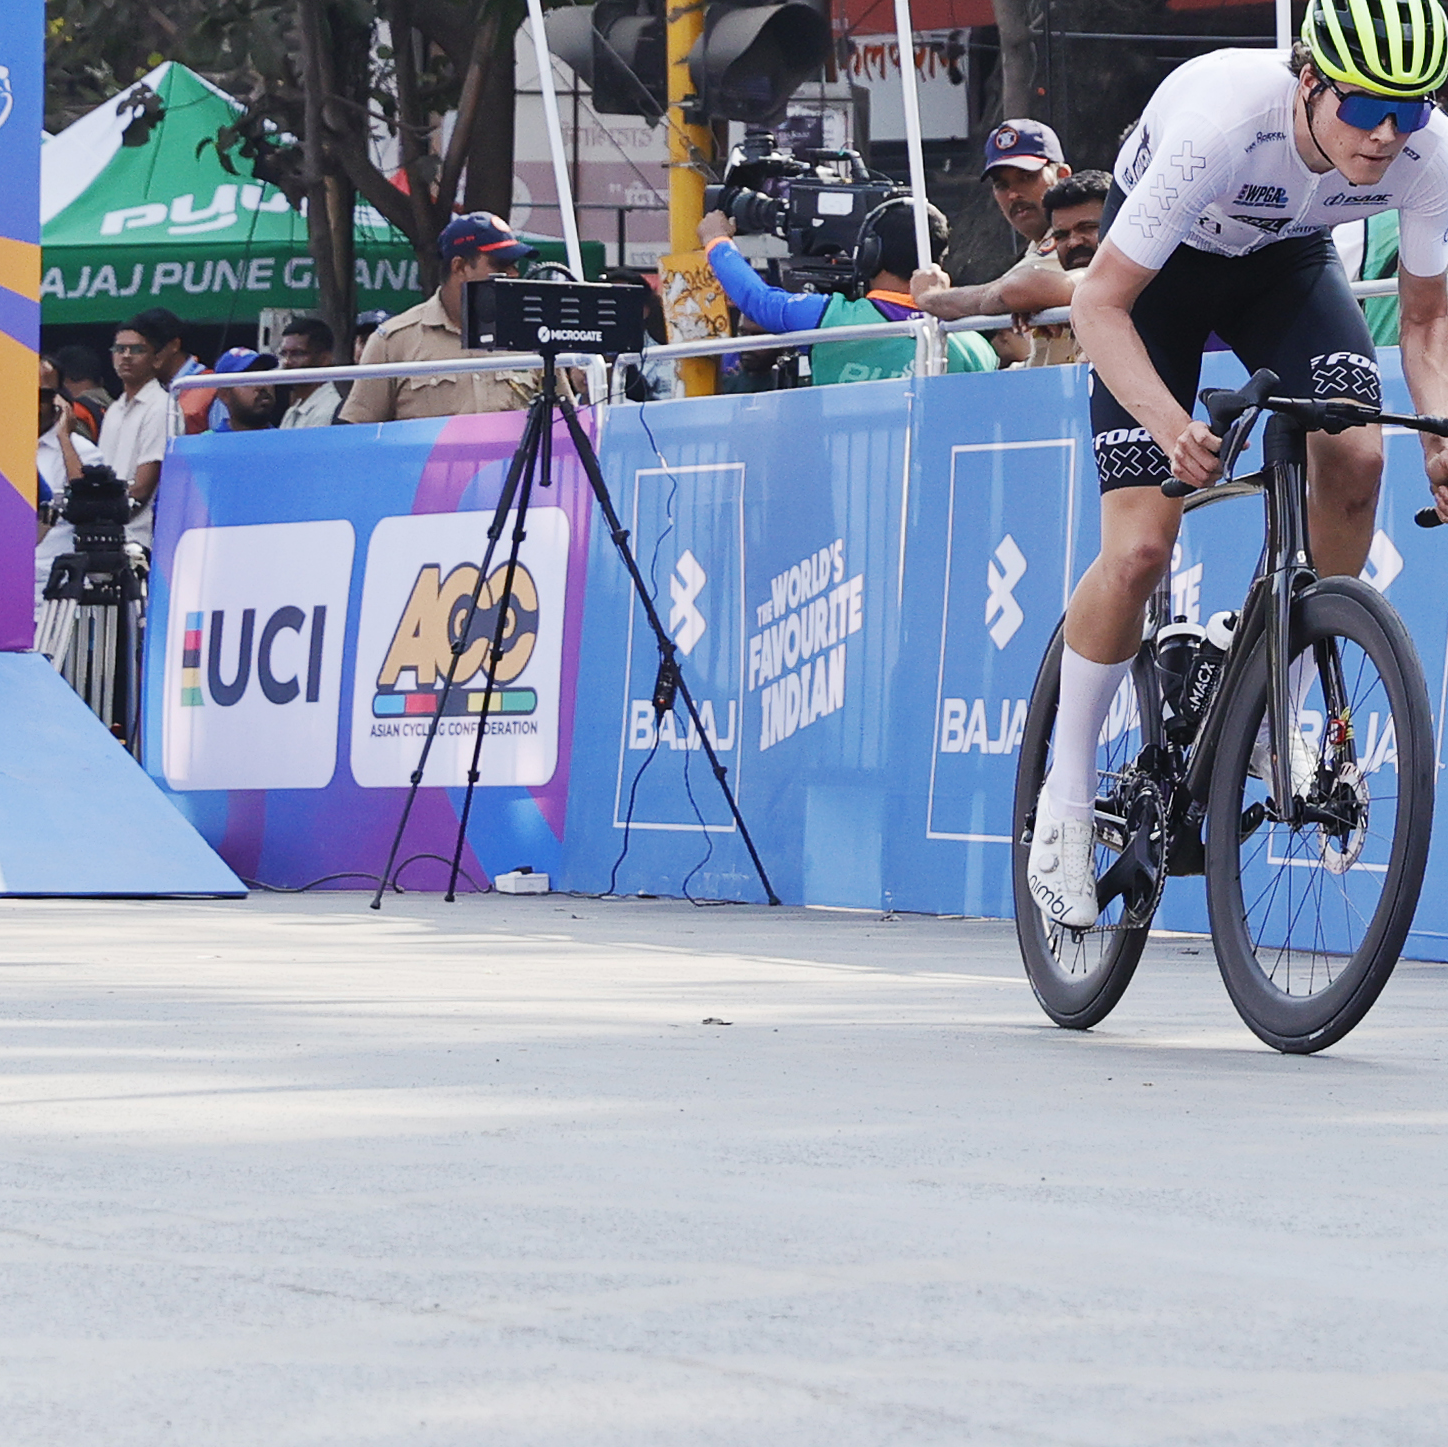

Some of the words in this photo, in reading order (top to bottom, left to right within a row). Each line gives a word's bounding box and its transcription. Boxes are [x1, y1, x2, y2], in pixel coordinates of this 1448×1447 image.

[150, 258, 277, 295] PUNE
[284, 257, 423, 291] GAN
[551, 329, 603, 342] MICROGATE
[757, 600, 773, 628] THE
[771, 538, 844, 615] WORLD'S
[207, 605, 328, 707] UCI
[376, 560, 540, 690] ACC
[748, 574, 863, 692] FAVOURITE
[370, 723, 400, 738] ASIAN
[403, 722, 446, 737] CYCLG
[448, 720, 538, 737] CONFDERATION
[628, 698, 736, 752] BAJAJ
[759, 642, 847, 752] INDIAN
[1028, 874, 1074, 921] nimbl
